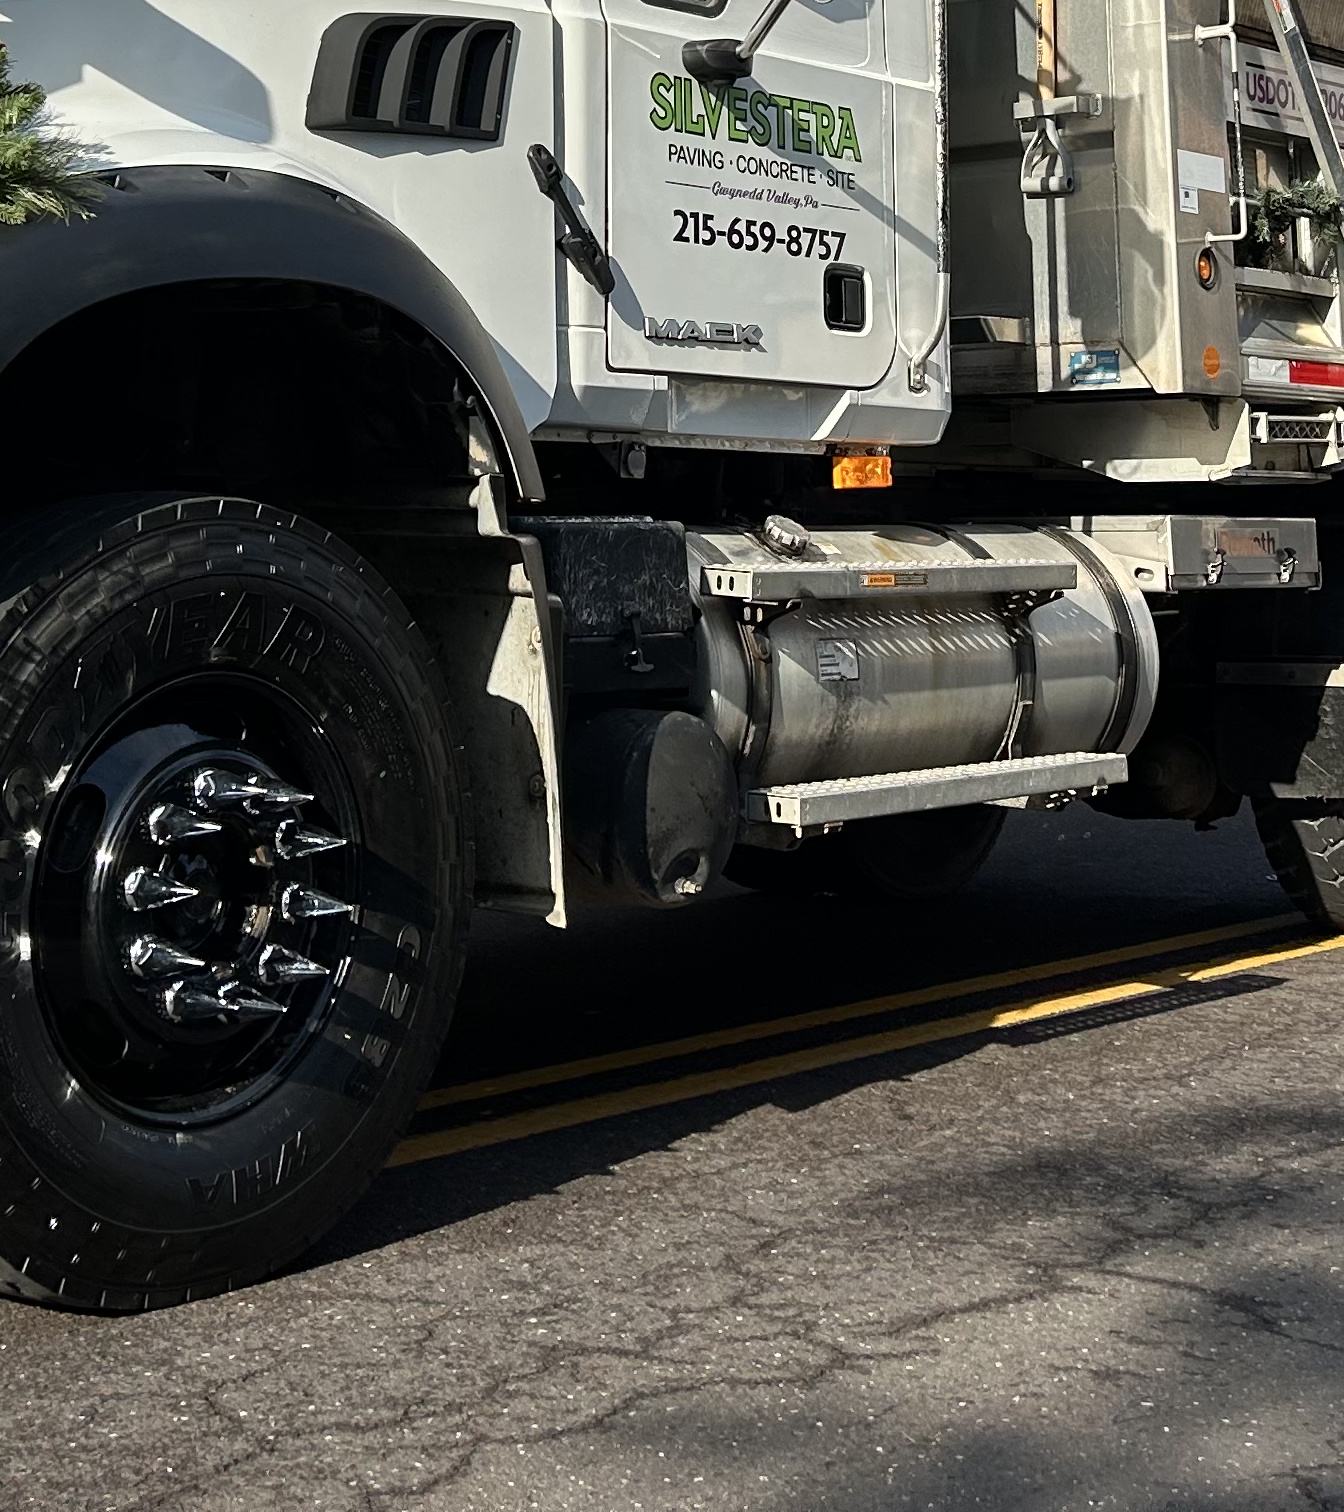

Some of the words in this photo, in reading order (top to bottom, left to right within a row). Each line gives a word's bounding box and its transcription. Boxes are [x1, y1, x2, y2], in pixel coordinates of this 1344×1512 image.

[1245, 71, 1296, 111] USDOT
[649, 71, 862, 163] SILVESTERA
[668, 143, 725, 170] PAVING
[736, 154, 816, 185] CONCRETE
[826, 170, 856, 190] SITE
[711, 180, 764, 201] Gwynedd
[672, 208, 847, 262] 215-659-8757
[644, 316, 765, 344] MACK
